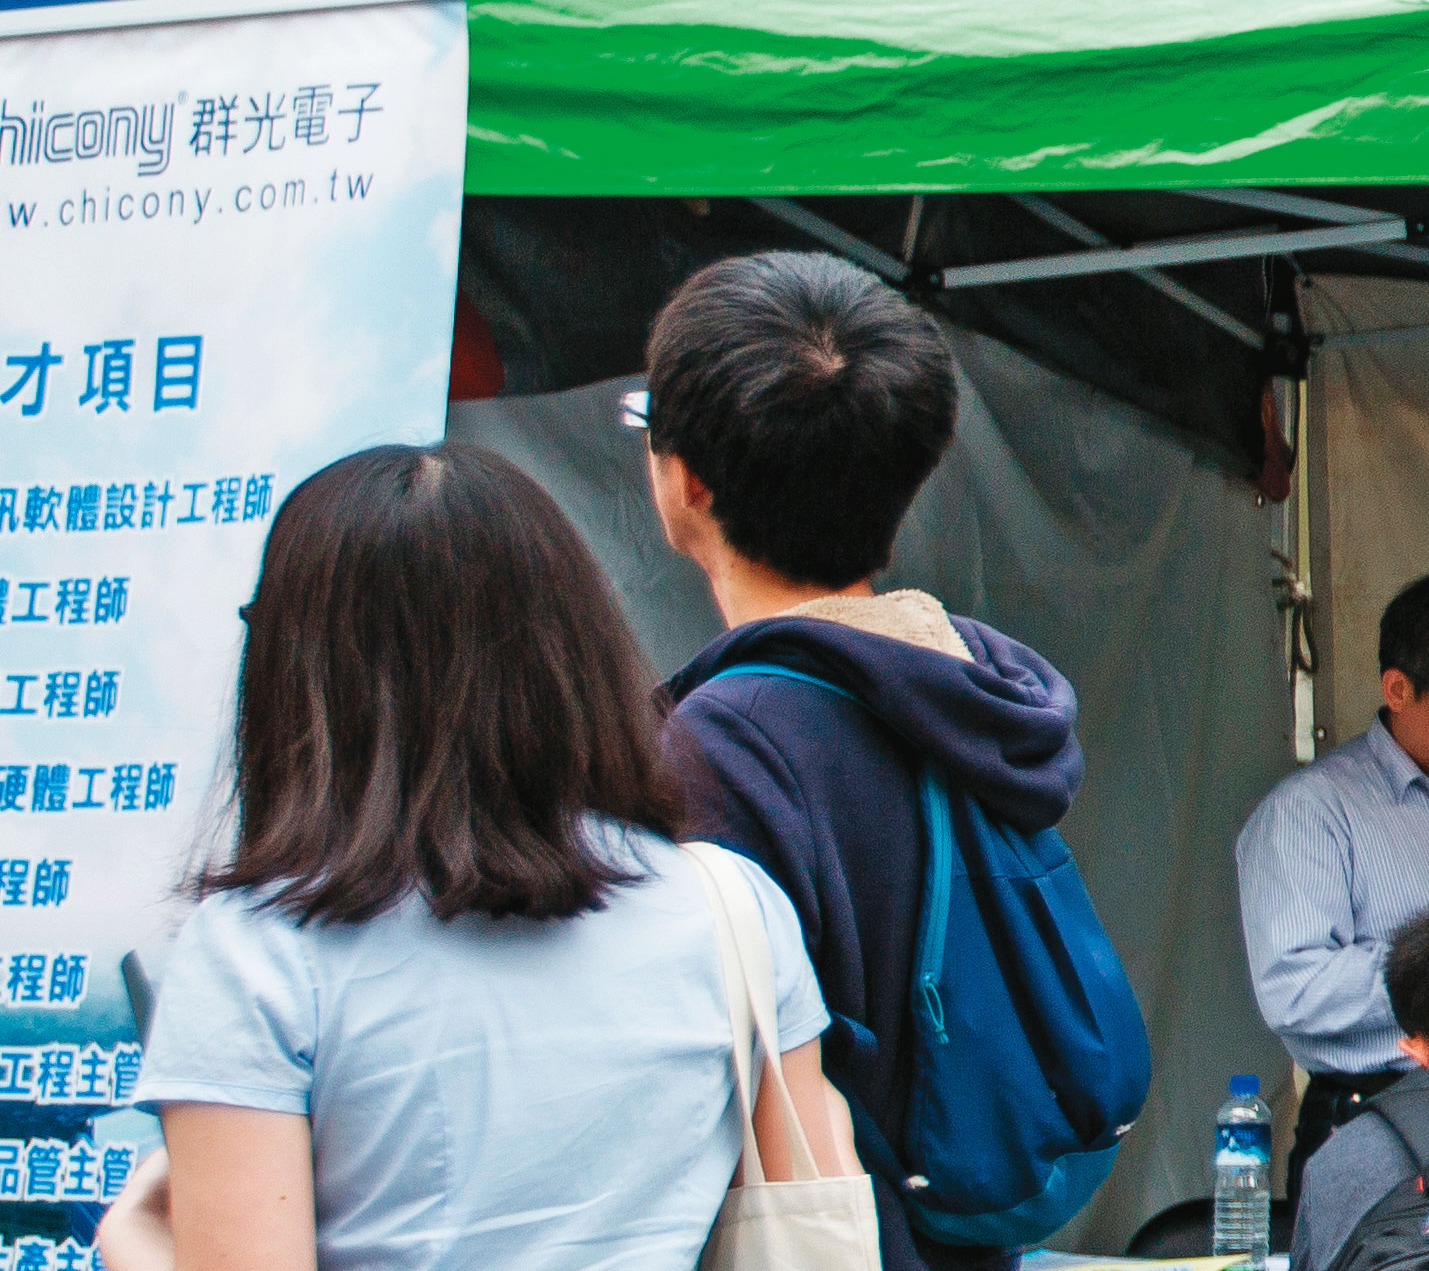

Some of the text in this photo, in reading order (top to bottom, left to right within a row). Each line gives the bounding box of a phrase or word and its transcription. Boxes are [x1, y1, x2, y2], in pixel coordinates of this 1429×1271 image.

[189, 82, 384, 158] 群光電子
[0, 335, 204, 416] 才項目
[0, 576, 130, 625] 工程師
[0, 671, 120, 718] 工程師
